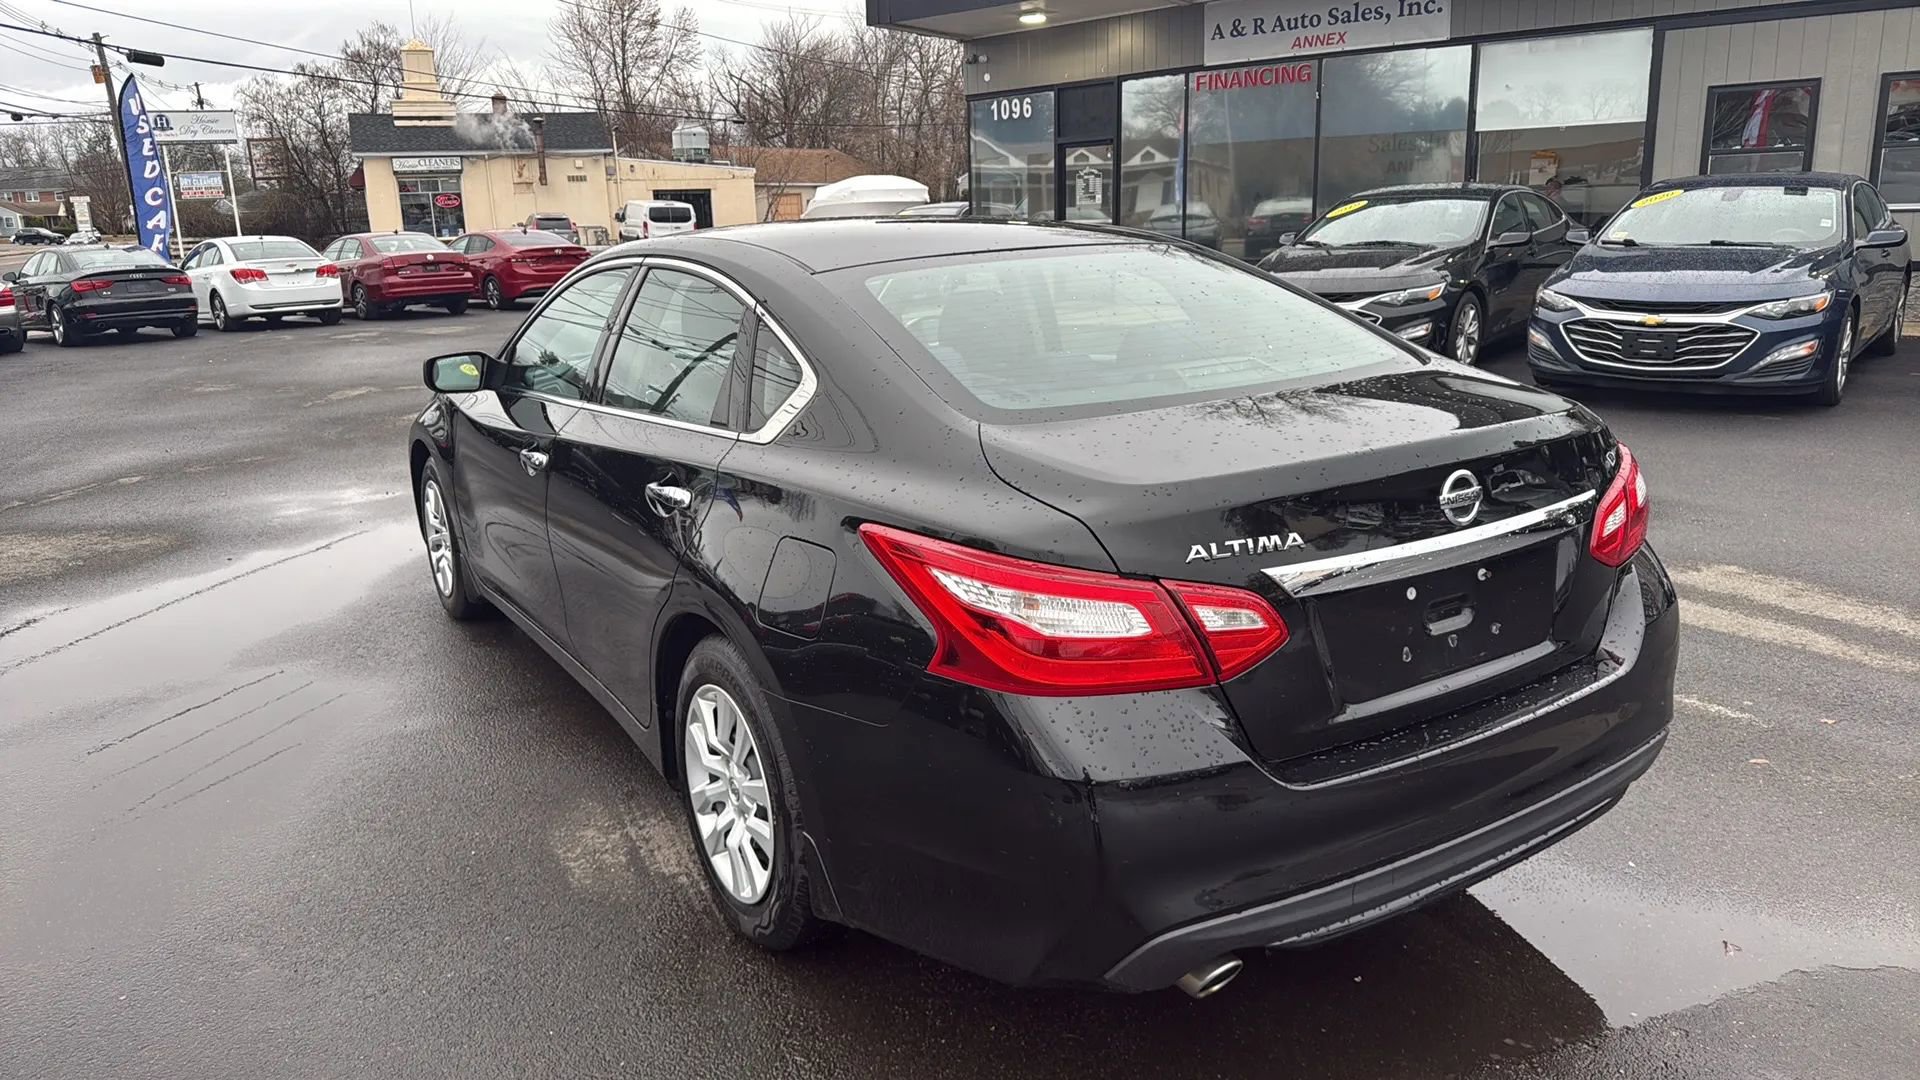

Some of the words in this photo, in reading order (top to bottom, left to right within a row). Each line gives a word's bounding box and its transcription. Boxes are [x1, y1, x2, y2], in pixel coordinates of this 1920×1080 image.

[1211, 23, 1225, 41] A
[1229, 18, 1247, 39] &
[1252, 17, 1267, 35] R
[1271, 11, 1322, 33] Auto
[1327, 1, 1392, 26] Sales,
[1397, 0, 1444, 19] Inc.
[1291, 31, 1348, 50] ANNEX
[1194, 63, 1313, 92] FINANCING
[990, 97, 1033, 121] 1096
[128, 94, 161, 179] USED
[199, 124, 235, 136] Cleaners
[417, 158, 460, 167] CLEANERS
[1185, 532, 1306, 564] ALTIMA
